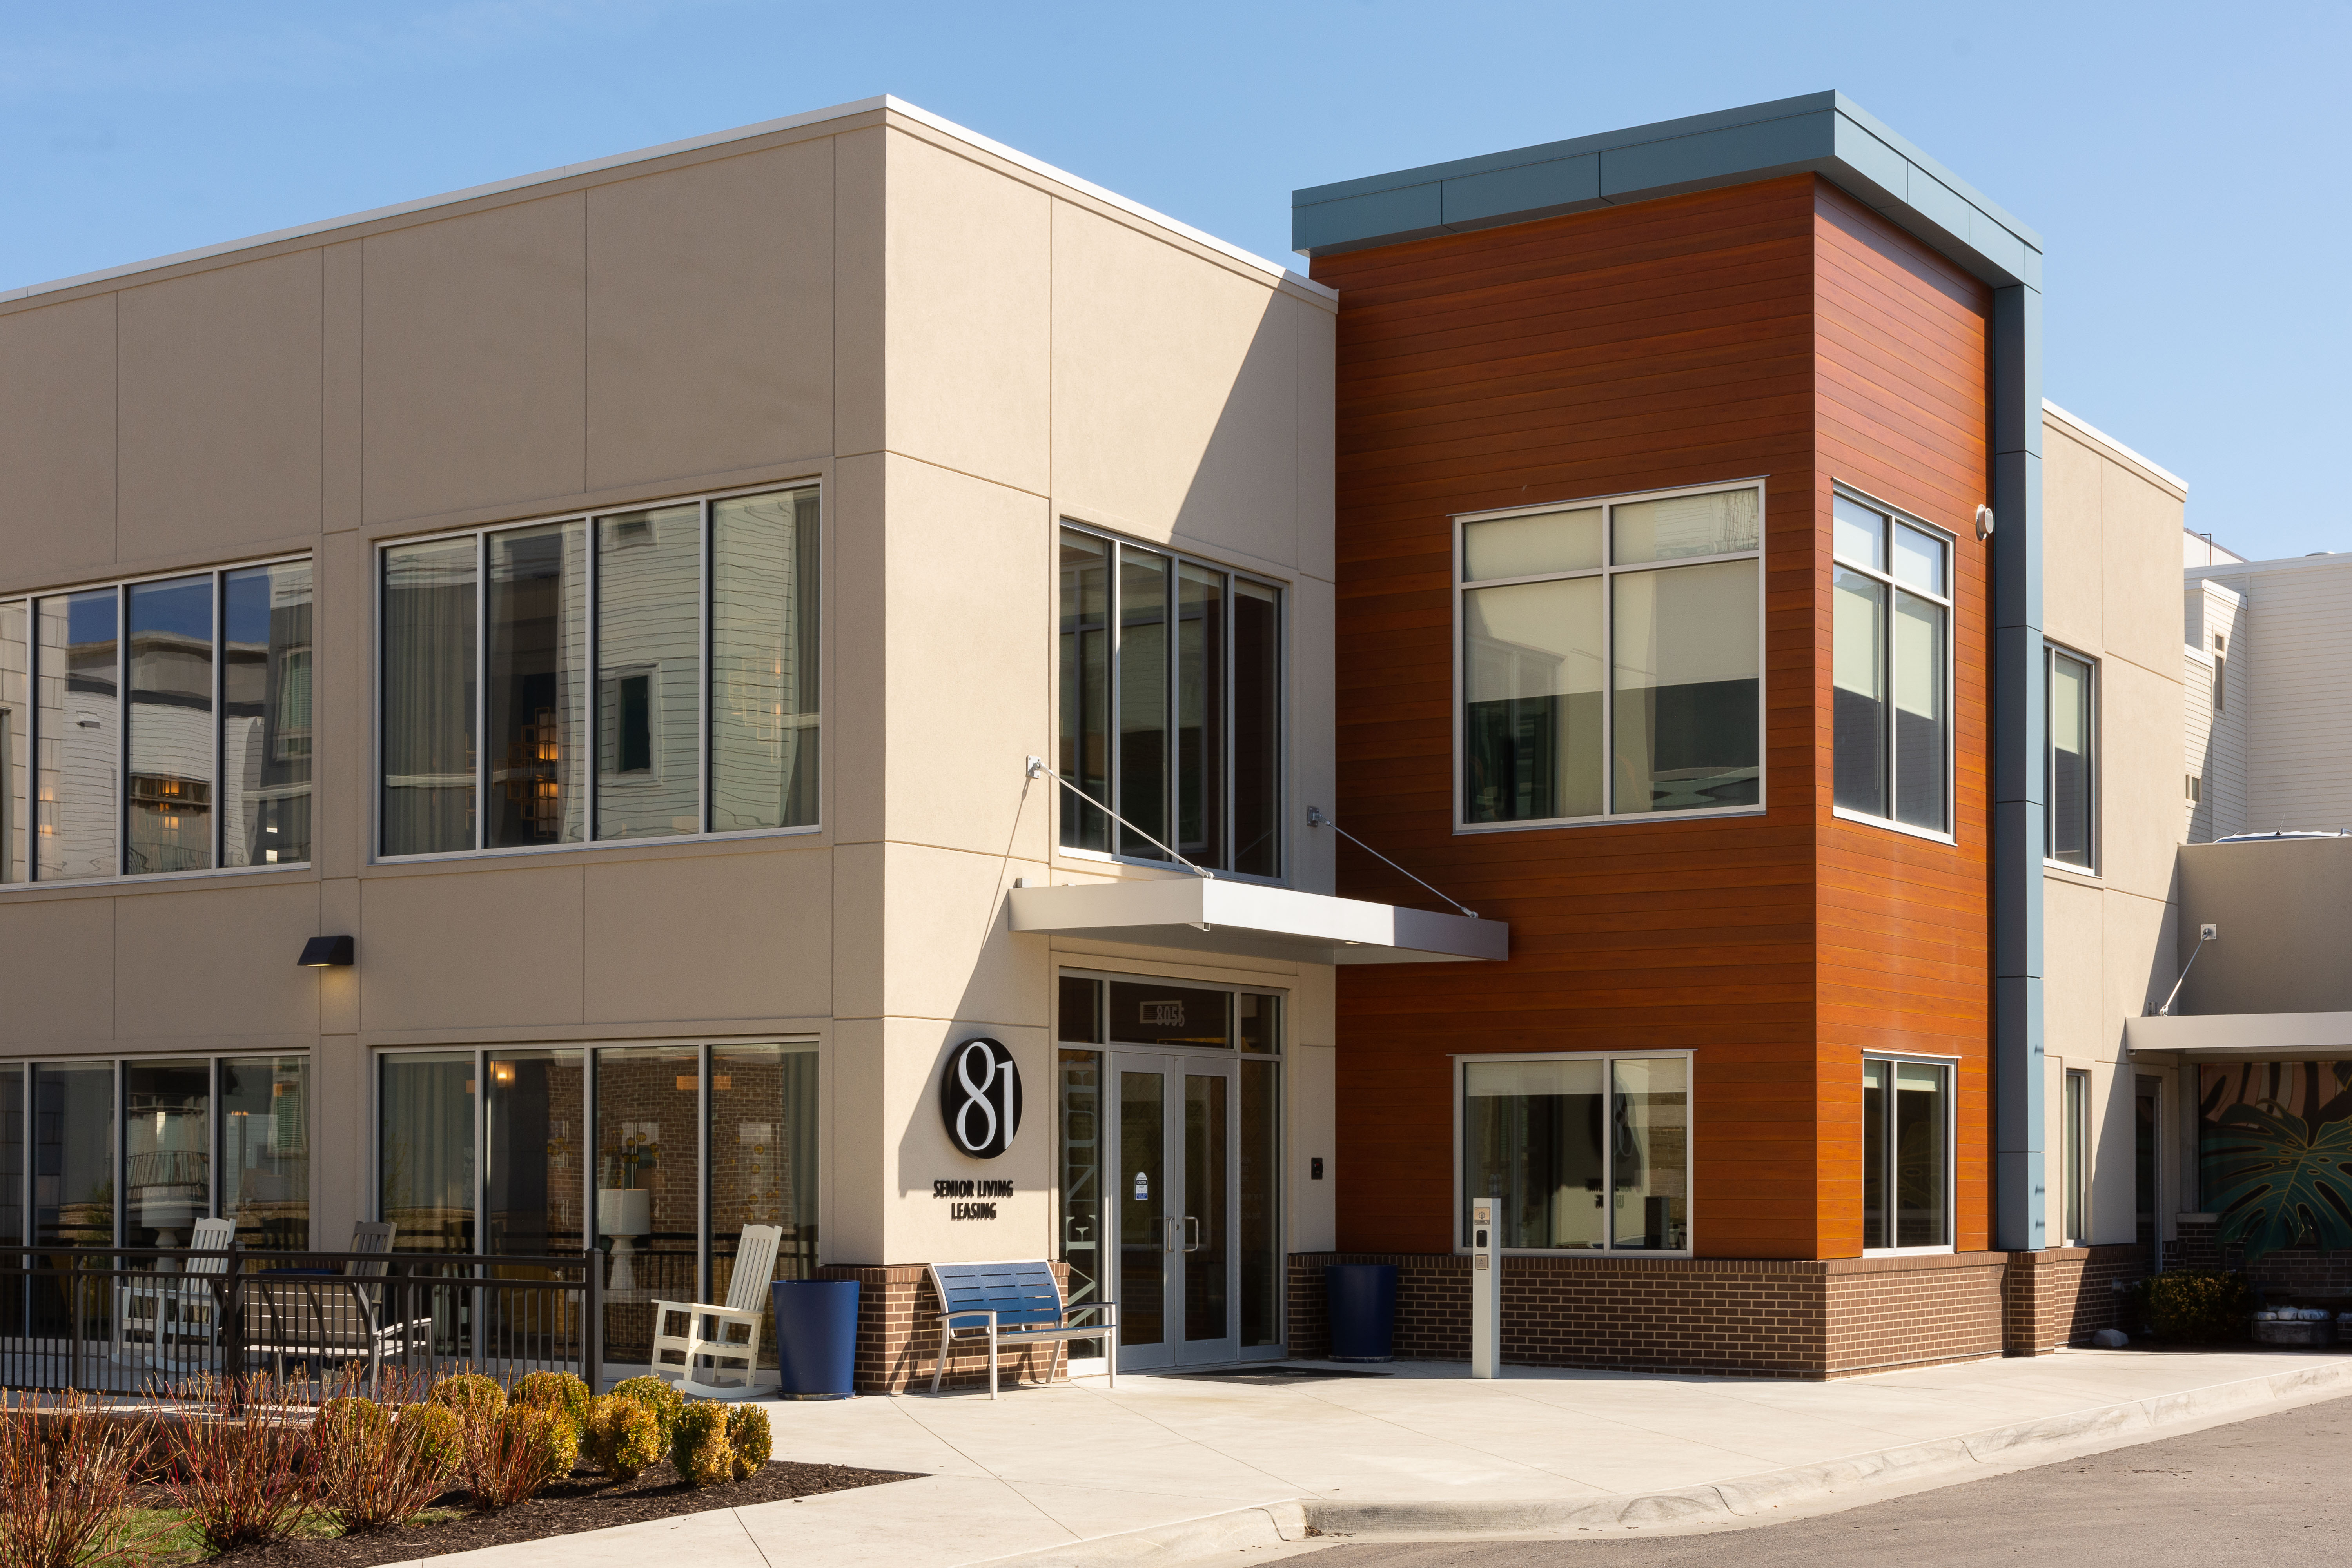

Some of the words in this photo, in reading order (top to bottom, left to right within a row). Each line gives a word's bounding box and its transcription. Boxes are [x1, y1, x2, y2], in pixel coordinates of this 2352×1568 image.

[1156, 1005, 1185, 1027] 8055
[956, 1041, 1013, 1150] 81
[933, 1180, 974, 1197] SENIOR
[978, 1180, 1014, 1197] LIVING
[951, 1202, 996, 1219] LEASING
